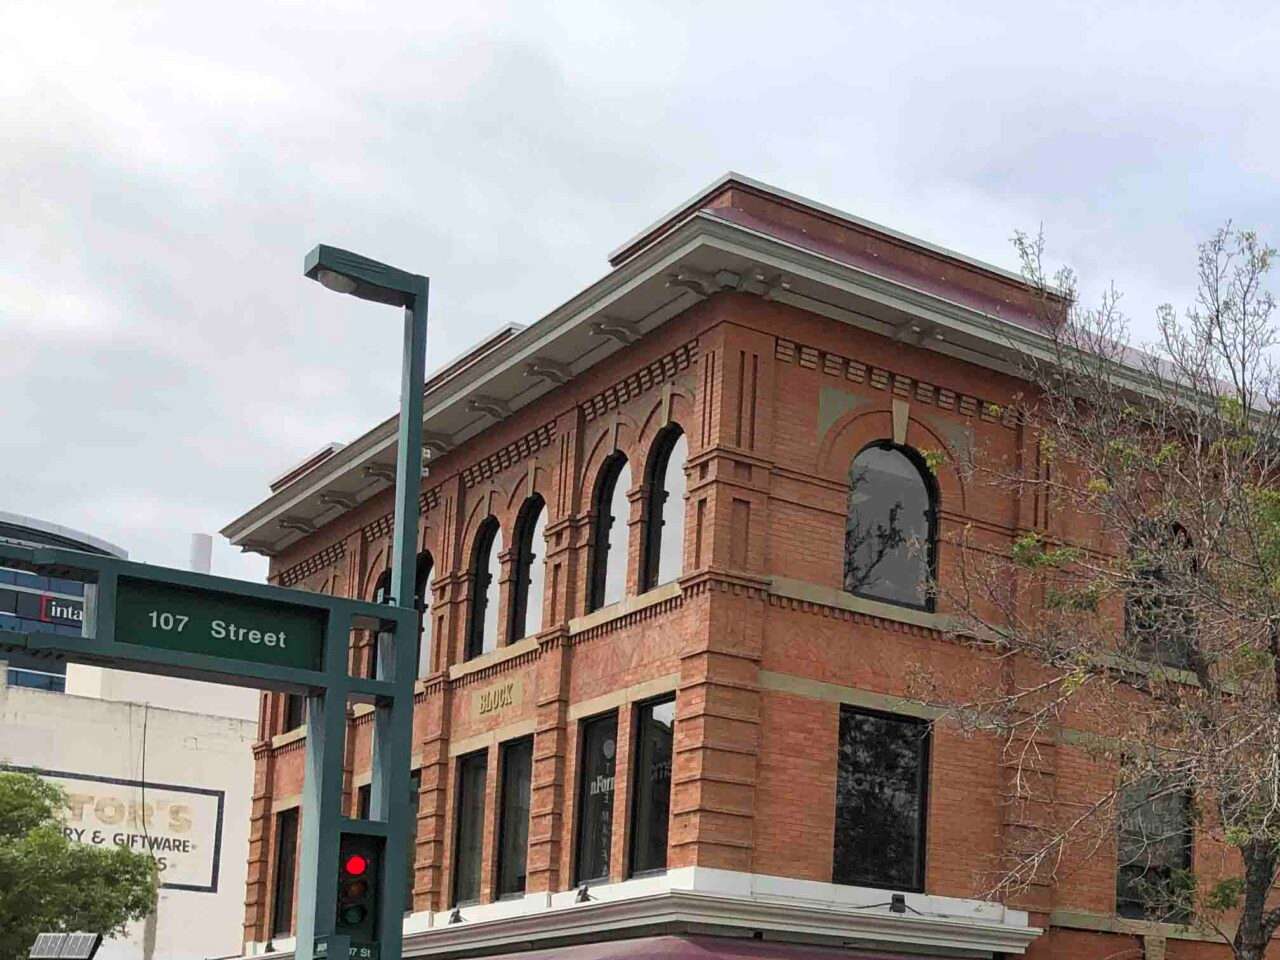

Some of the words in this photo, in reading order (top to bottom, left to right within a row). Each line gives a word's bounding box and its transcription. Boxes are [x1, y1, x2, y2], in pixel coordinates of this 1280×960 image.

[51, 601, 83, 620] inta
[148, 610, 189, 632] 107
[211, 620, 286, 648] Street
[480, 683, 514, 715] BLOCK
[69, 793, 193, 832] TOR'S
[63, 826, 86, 842] RY
[91, 830, 106, 844] &
[112, 832, 191, 853] GIFTWARE
